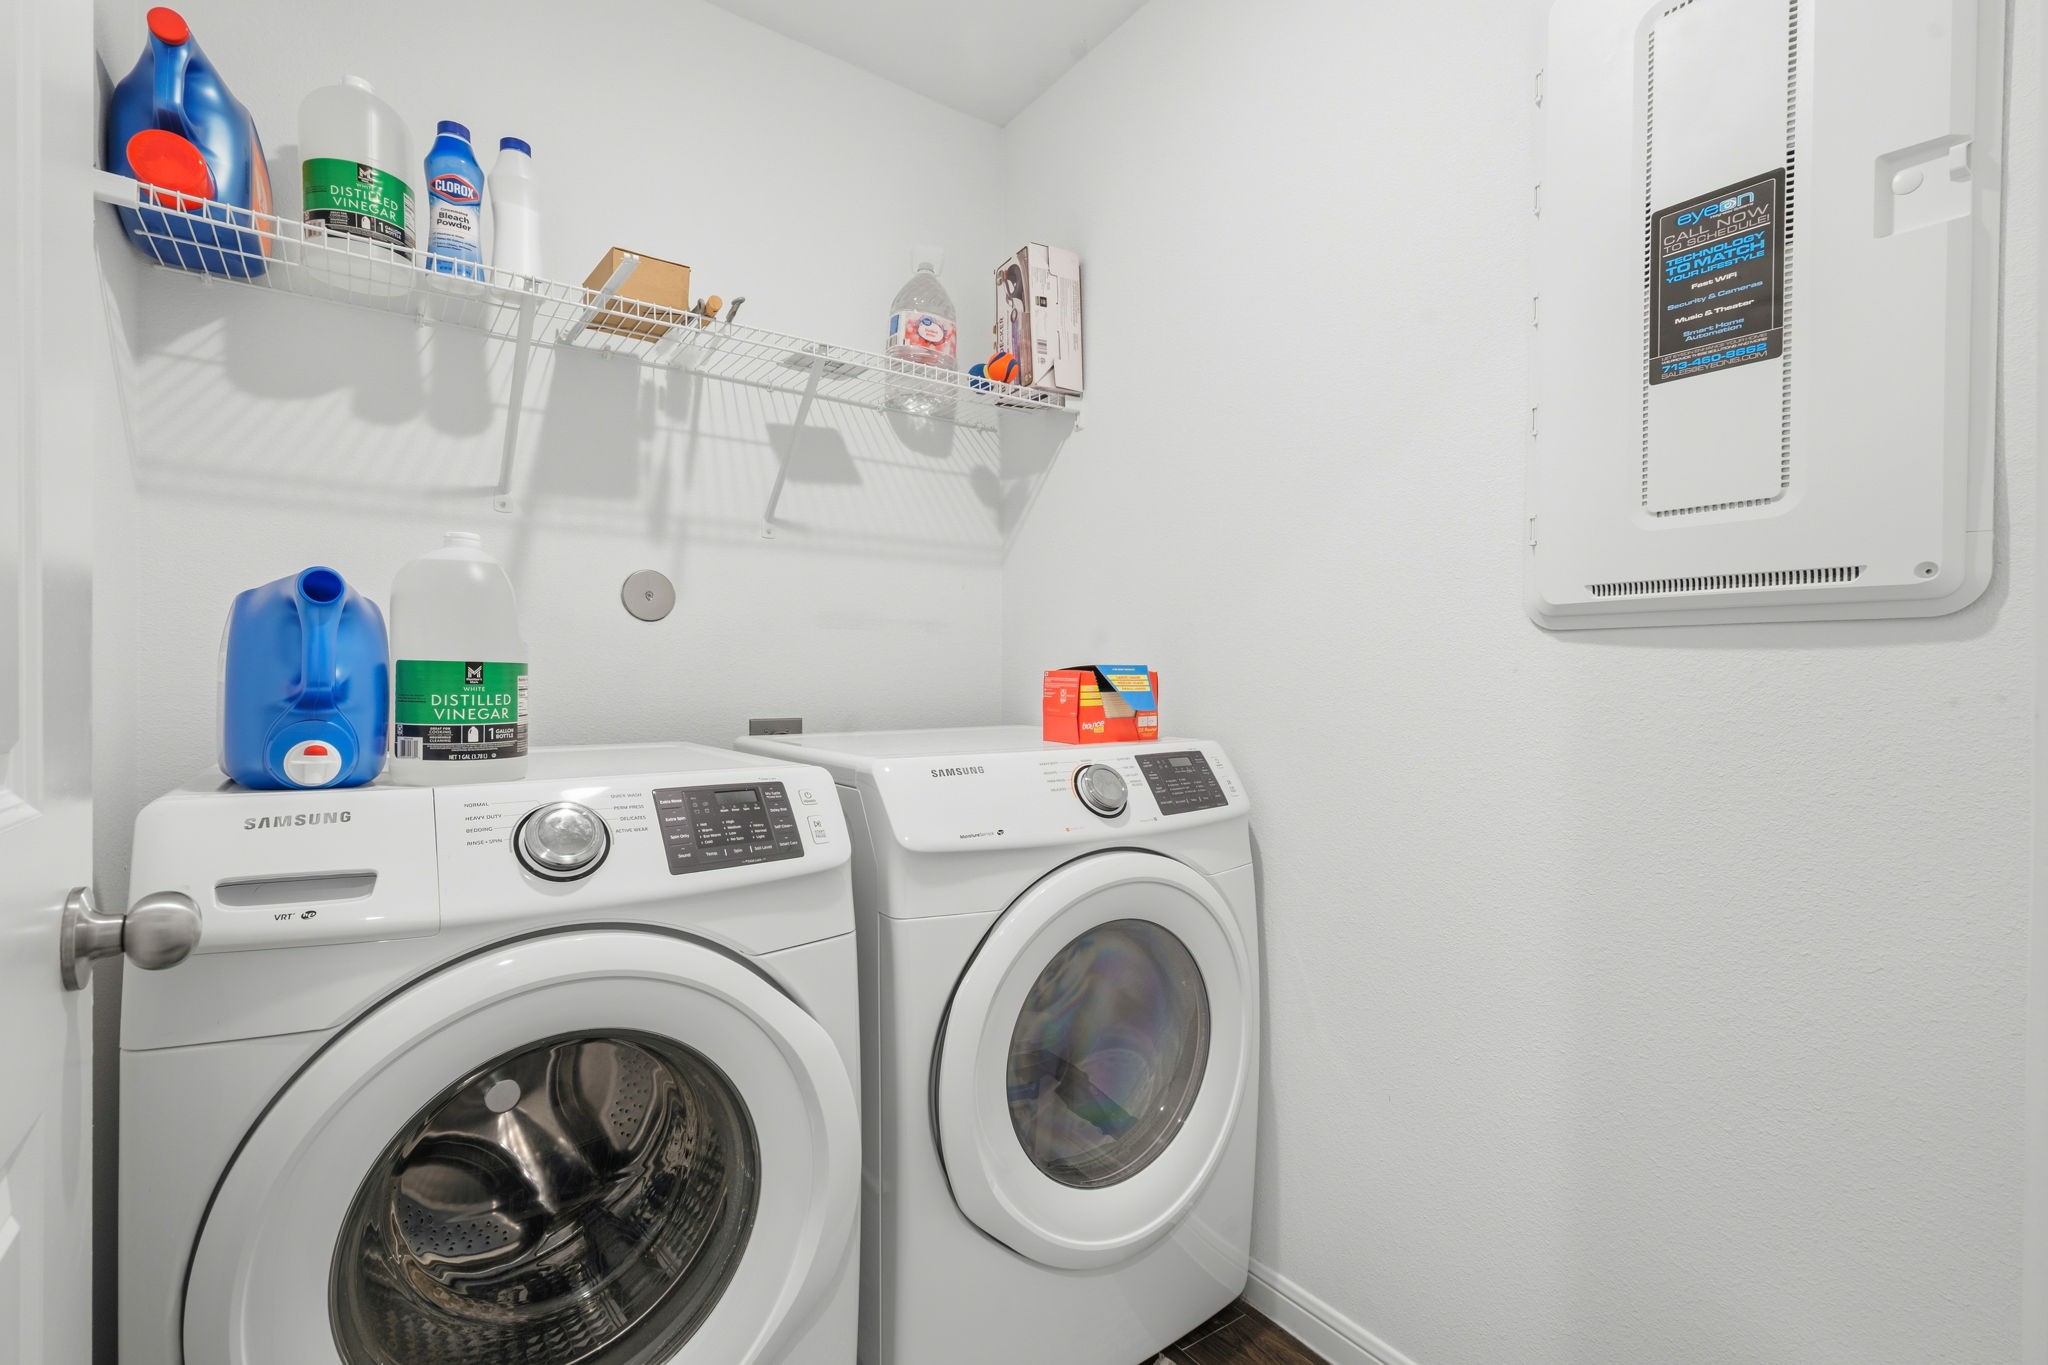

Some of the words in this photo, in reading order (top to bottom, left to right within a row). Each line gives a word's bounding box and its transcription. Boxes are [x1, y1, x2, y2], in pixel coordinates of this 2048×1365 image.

[330, 185, 399, 211] DISTILLED
[435, 180, 474, 199] CLOROX
[332, 196, 397, 222] VINEGAR
[438, 212, 470, 225] Bleach
[379, 222, 385, 233] 1
[436, 219, 471, 232] Powder
[1663, 225, 1710, 246] CALL
[1717, 203, 1769, 228] NOW
[1664, 243, 1682, 254] TO
[1687, 213, 1770, 247] SCHEDULE!
[1666, 231, 1765, 267] TECHNOLOGY
[1666, 263, 1690, 277] TO
[1694, 239, 1765, 268] MATCH
[1666, 270, 1699, 284] YOUR
[1701, 250, 1765, 274] LIFESTYLE
[1691, 280, 1714, 290] Fast
[1715, 271, 1738, 283] WiFi
[1667, 296, 1707, 311] Security
[1718, 281, 1763, 297] Cameras
[1675, 313, 1703, 325] Music
[1714, 299, 1754, 314] Theater
[1683, 325, 1714, 338] Smart
[1716, 318, 1744, 329] Home
[1685, 324, 1743, 342] Automation
[1662, 342, 1768, 373] 713-460-8662
[431, 694, 512, 706] DISTILLED
[434, 708, 510, 720] VINEGAR
[488, 727, 494, 740] 1
[931, 766, 985, 778] SAMSUNG
[244, 811, 351, 830] SAMSUNG
[274, 912, 292, 921] VRT
